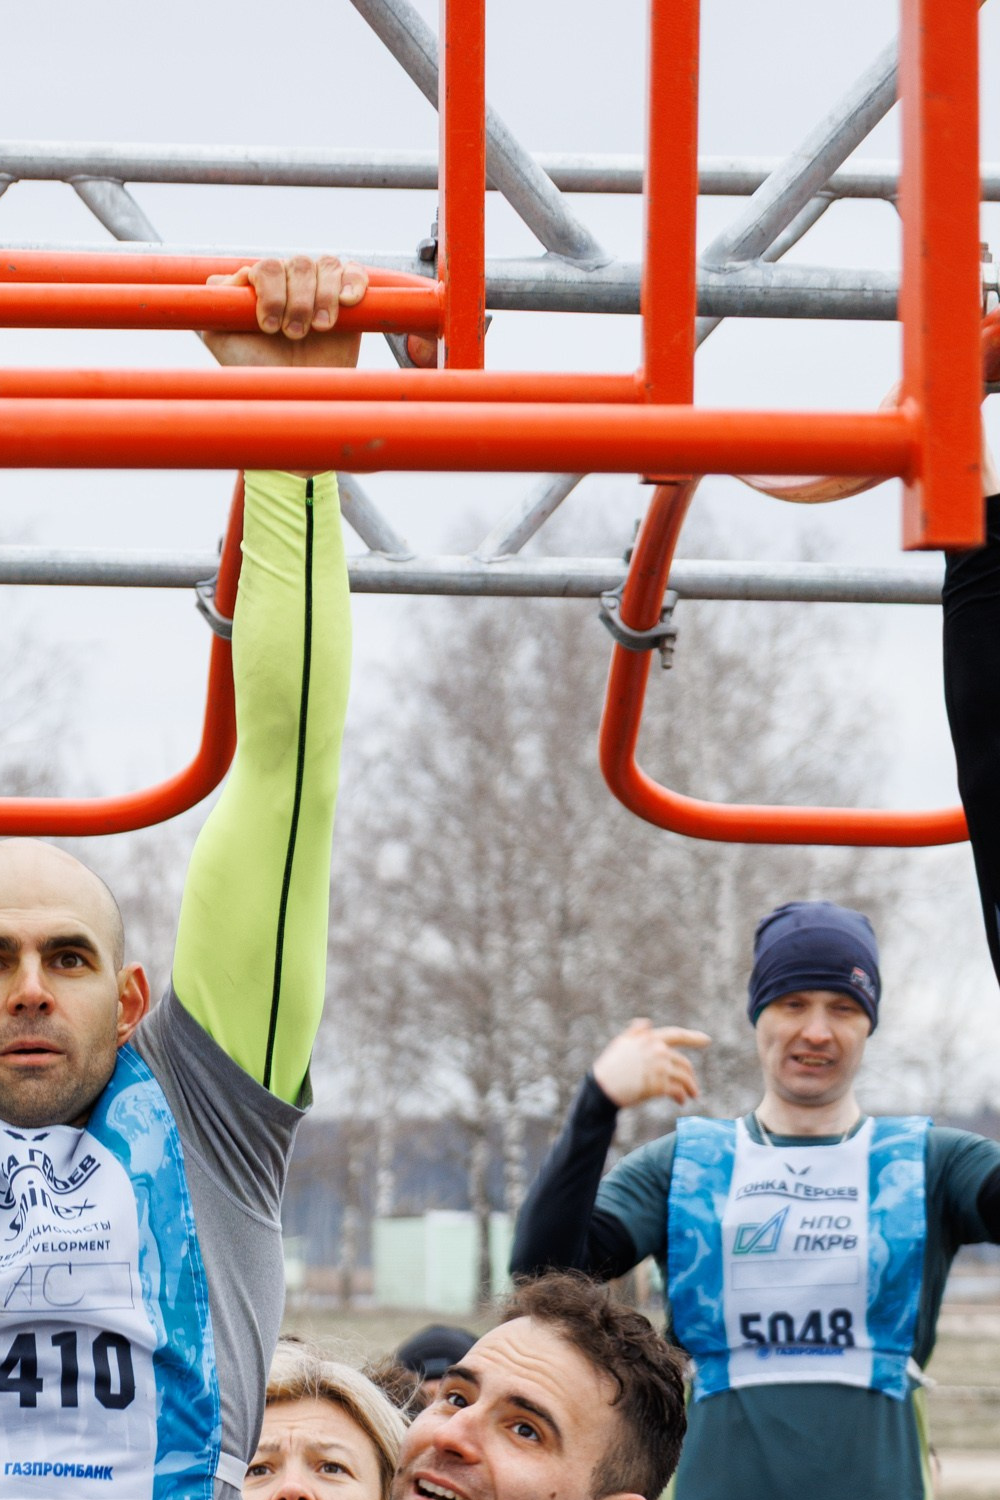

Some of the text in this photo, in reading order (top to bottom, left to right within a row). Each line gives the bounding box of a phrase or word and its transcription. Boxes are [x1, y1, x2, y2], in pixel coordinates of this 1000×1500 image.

[28, 1148, 97, 1191] ГЕРОЕВ
[794, 1183, 858, 1197] ГЕРОЕВ
[800, 1215, 851, 1229] НПО
[31, 1240, 111, 1253] VELOPMENT
[794, 1234, 857, 1252] ПКРВ
[740, 1308, 855, 1347] 5048
[4, 1461, 114, 1481] ГАЗПРОМБАНК
